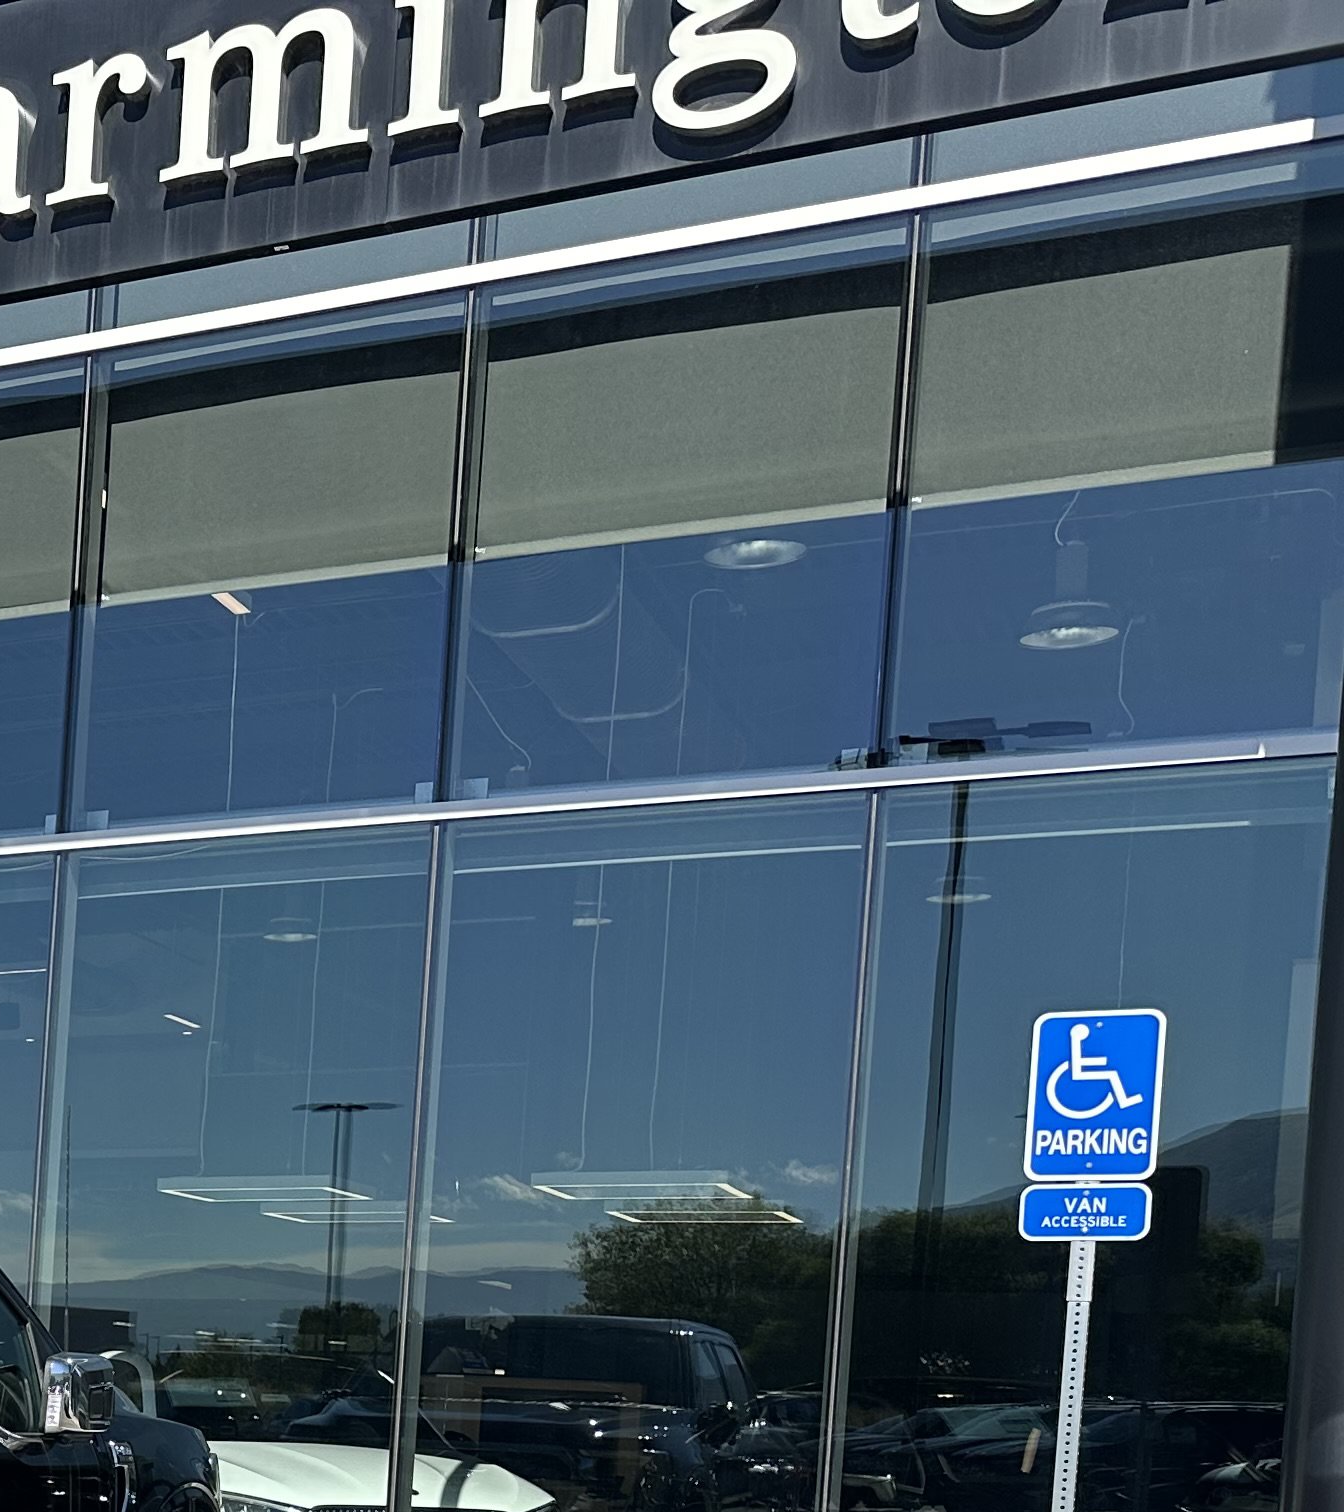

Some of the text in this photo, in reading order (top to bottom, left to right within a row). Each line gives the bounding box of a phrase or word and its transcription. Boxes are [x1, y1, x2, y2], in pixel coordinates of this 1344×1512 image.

[1035, 1127, 1148, 1156] PARKING
[1064, 1197, 1107, 1213] VAN
[1040, 1215, 1127, 1228] ACCESSIBLE
